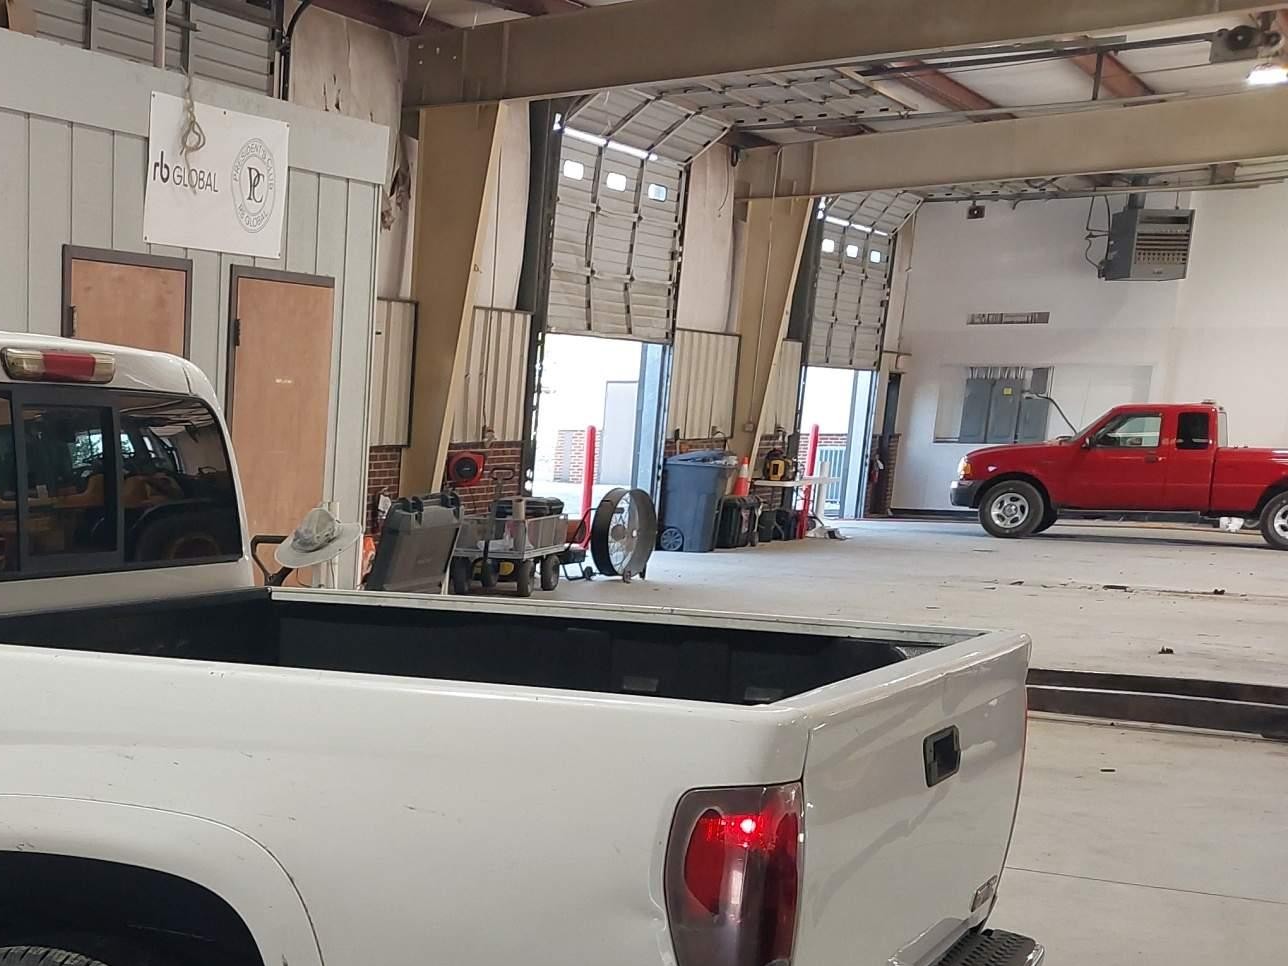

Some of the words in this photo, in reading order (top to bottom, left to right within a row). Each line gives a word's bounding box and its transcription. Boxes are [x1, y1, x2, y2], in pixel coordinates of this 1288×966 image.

[153, 150, 170, 184] rb
[172, 165, 219, 193] GLOBAL
[245, 210, 268, 228] GLOBAL
